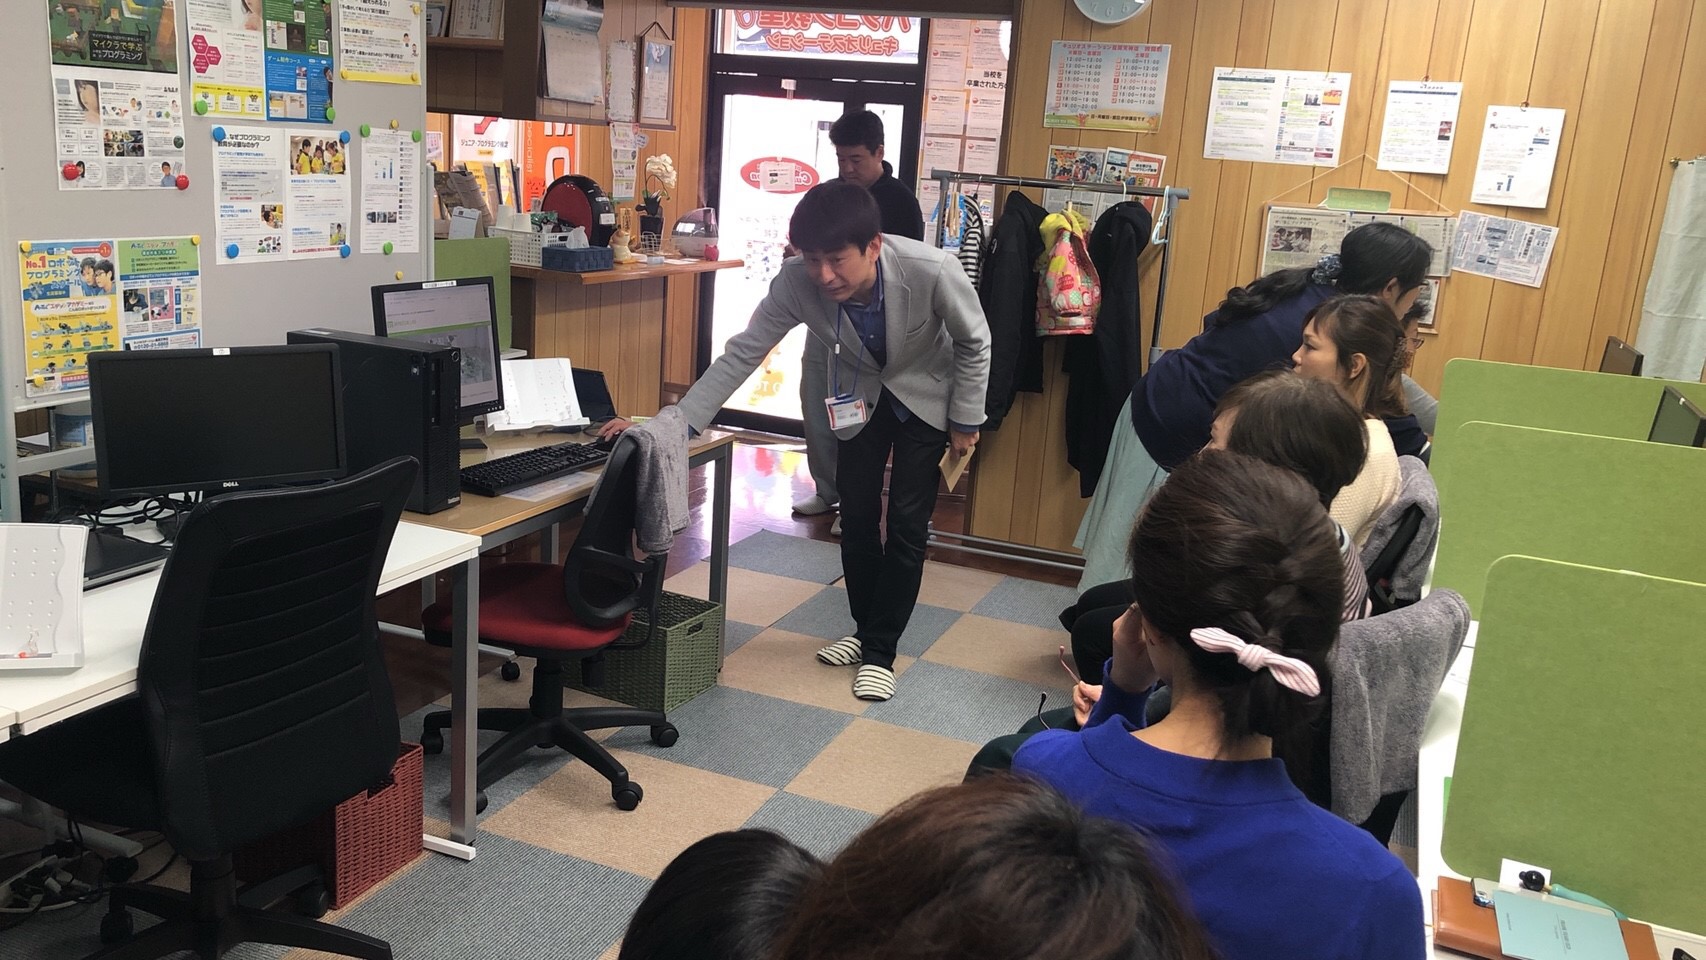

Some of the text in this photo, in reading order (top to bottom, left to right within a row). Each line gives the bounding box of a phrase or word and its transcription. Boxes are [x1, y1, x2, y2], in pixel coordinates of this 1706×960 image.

[93, 39, 144, 52] マイクラで学ぶ
[102, 49, 144, 61] プログラミング
[983, 70, 1003, 78] 当校を
[26, 255, 47, 269] No.1
[27, 269, 81, 280] プログラミング
